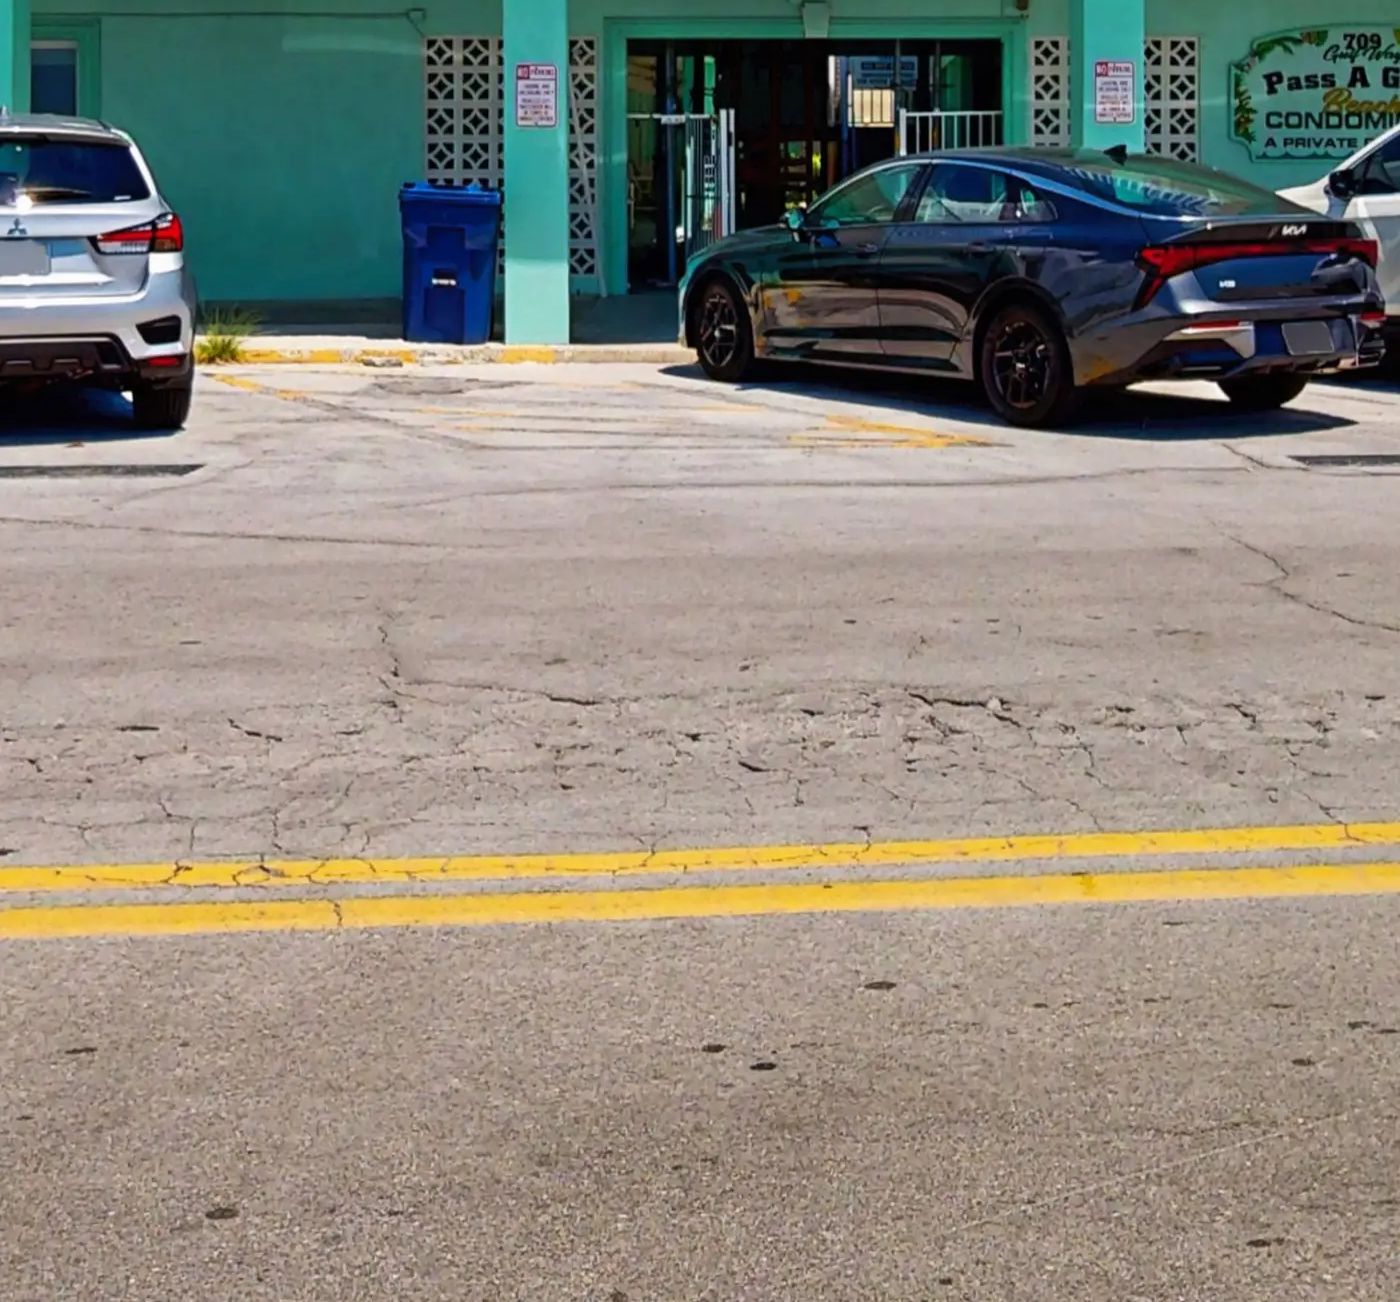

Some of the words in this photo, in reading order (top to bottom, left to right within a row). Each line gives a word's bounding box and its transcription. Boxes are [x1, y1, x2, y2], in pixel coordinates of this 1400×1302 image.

[1343, 33, 1382, 50] 709
[1323, 44, 1360, 64] Gulf
[1263, 71, 1336, 95] Pass
[1347, 66, 1371, 88] A
[1265, 111, 1400, 130] CONDOMI
[1264, 137, 1277, 148] A
[1283, 137, 1358, 148] PRIVATE
[1281, 224, 1307, 237] KIA
